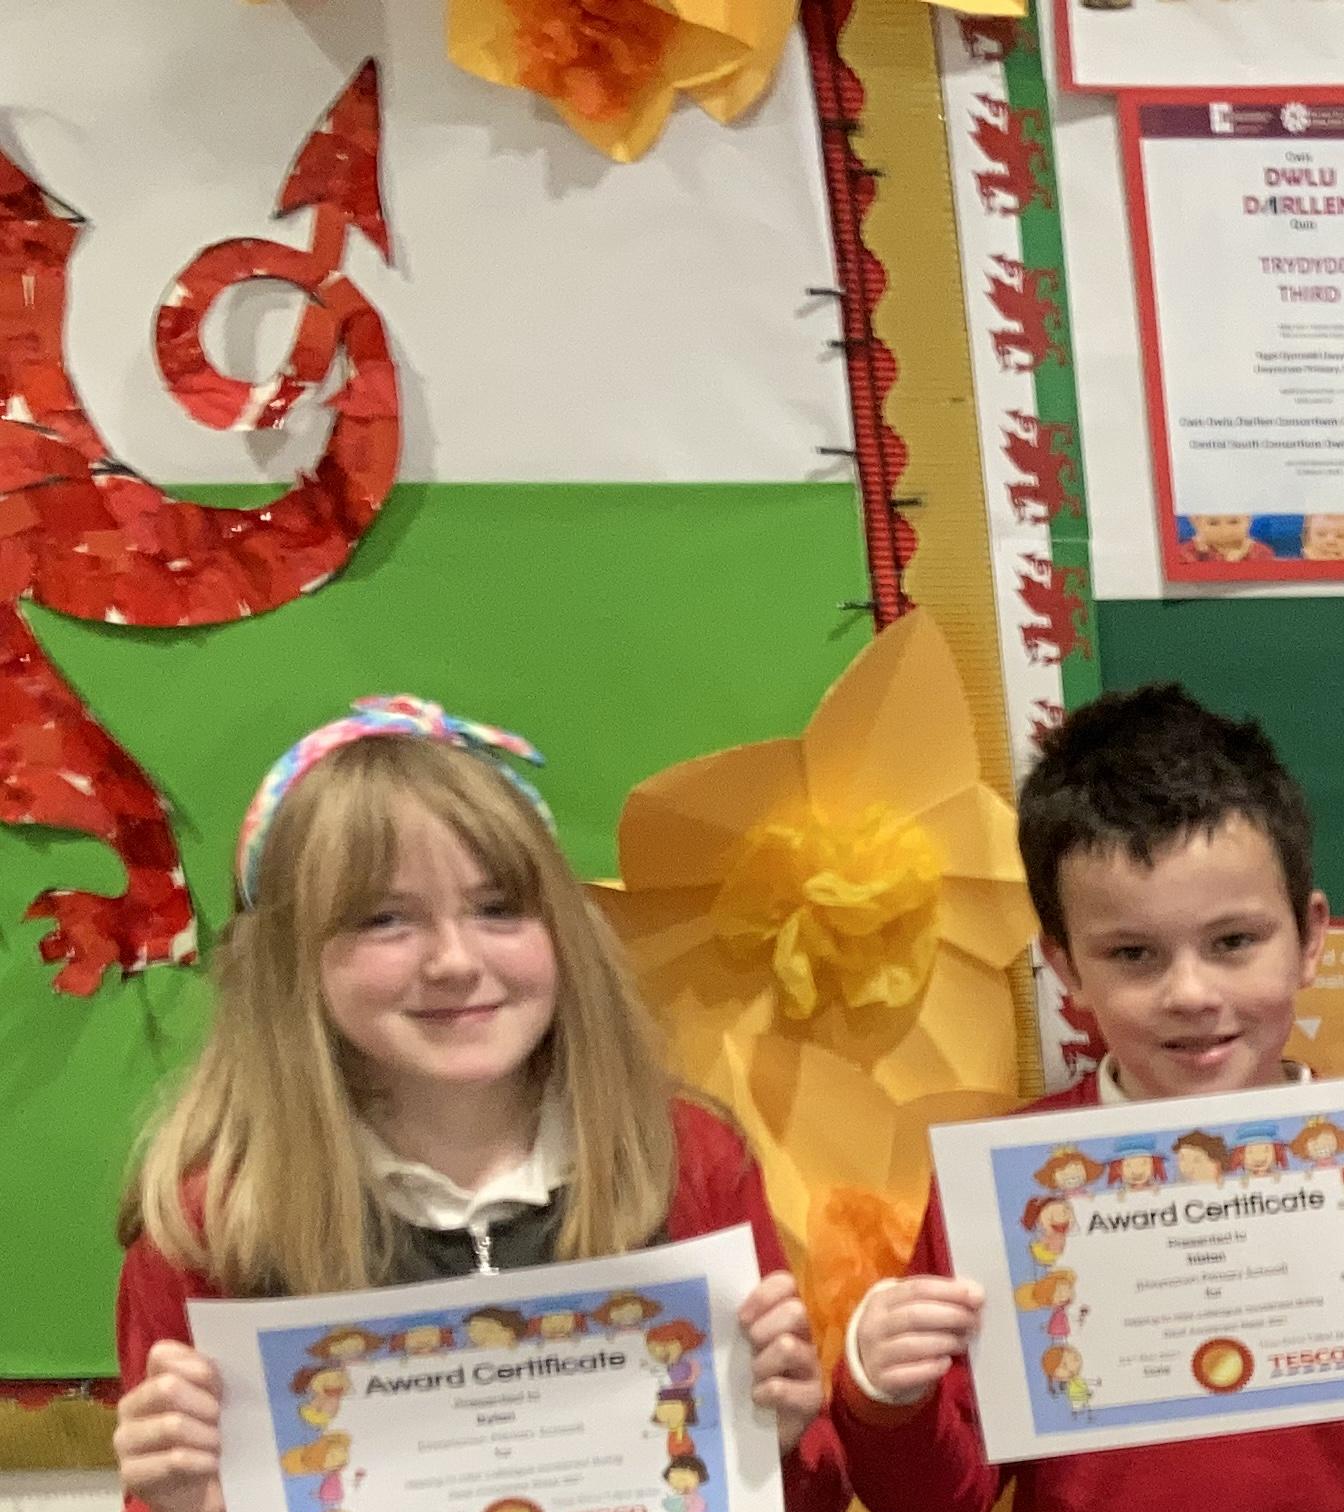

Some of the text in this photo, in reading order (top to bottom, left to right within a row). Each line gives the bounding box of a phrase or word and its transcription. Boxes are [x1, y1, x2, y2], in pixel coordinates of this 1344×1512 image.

[1264, 168, 1337, 187] DWLU
[1278, 285, 1341, 303] THIRD
[1086, 1186, 1326, 1236] Award Certificate
[366, 1351, 626, 1396] Award Certificate
